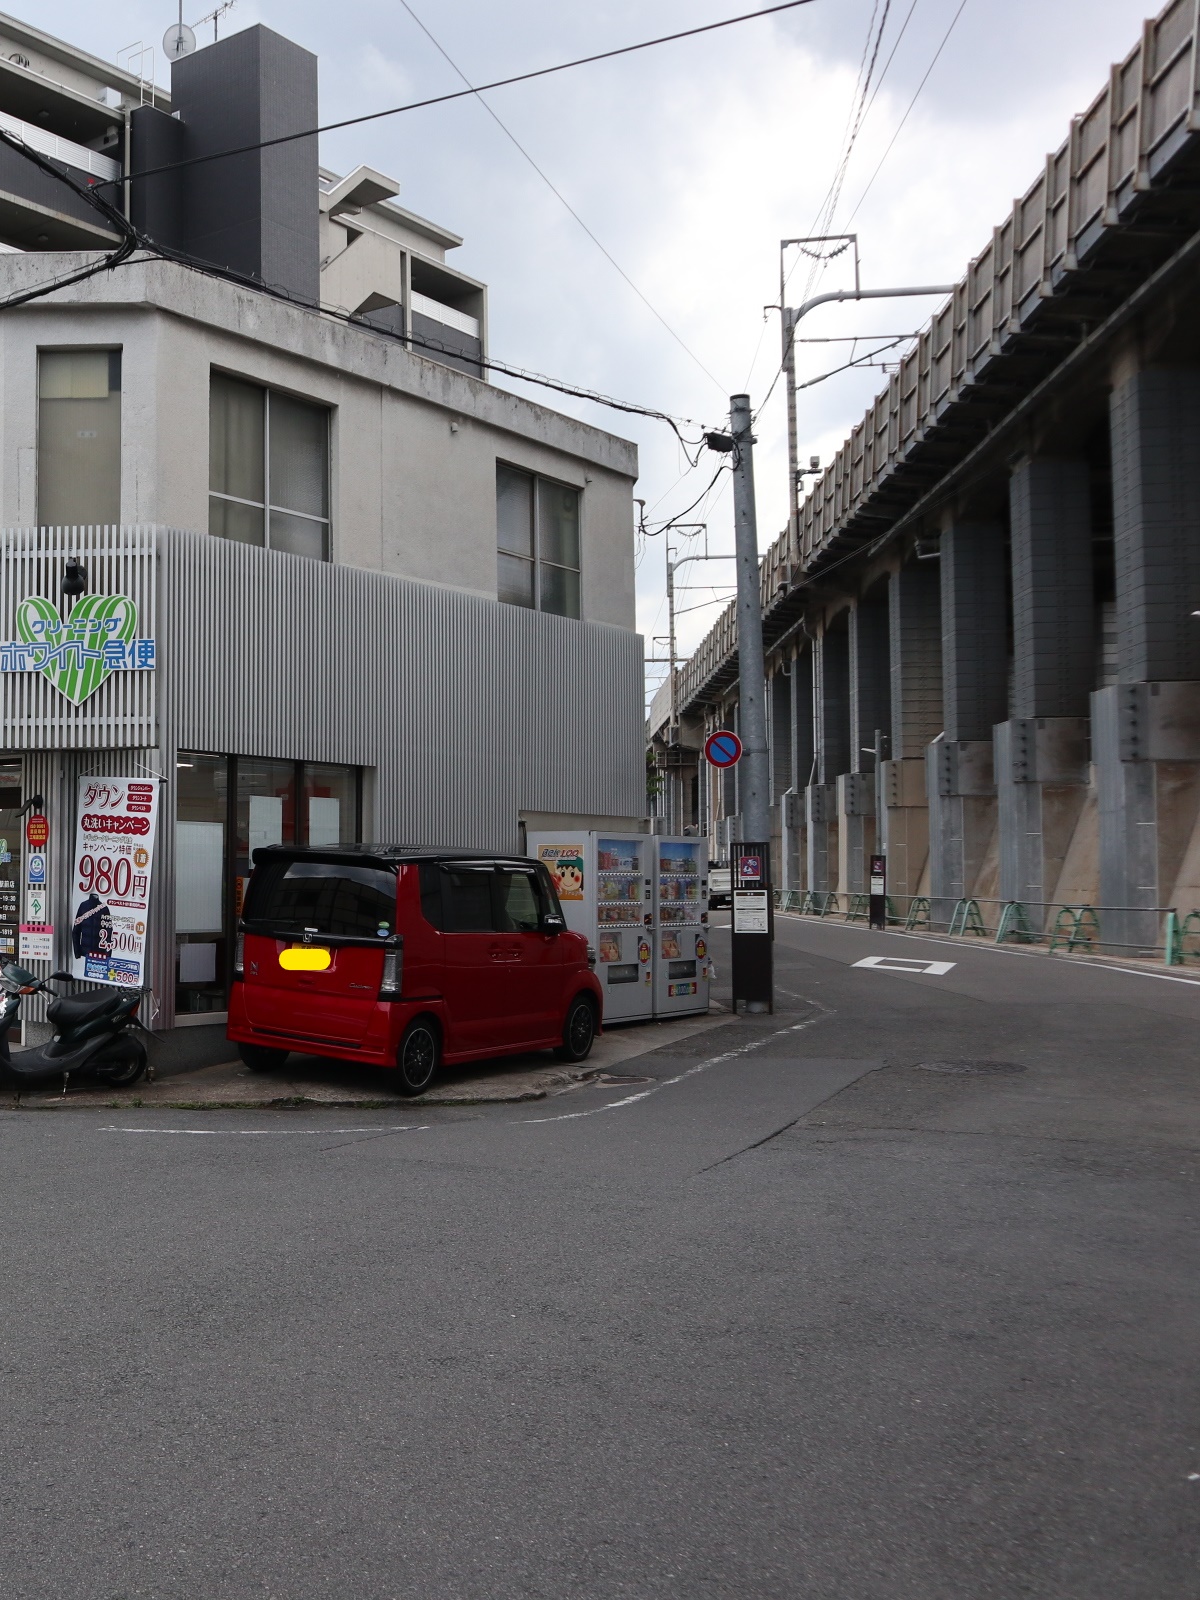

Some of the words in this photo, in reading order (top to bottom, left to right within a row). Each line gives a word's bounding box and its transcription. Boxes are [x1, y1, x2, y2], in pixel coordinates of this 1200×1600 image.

[31, 617, 122, 635] クリーニング
[0, 639, 156, 672] ホワイト急便
[83, 782, 126, 810] ダウン
[82, 816, 150, 832] 丸洗いキャンペーン
[83, 842, 133, 855] キャンペーン特価
[79, 854, 148, 898] 980円
[99, 929, 142, 953] 2,500円
